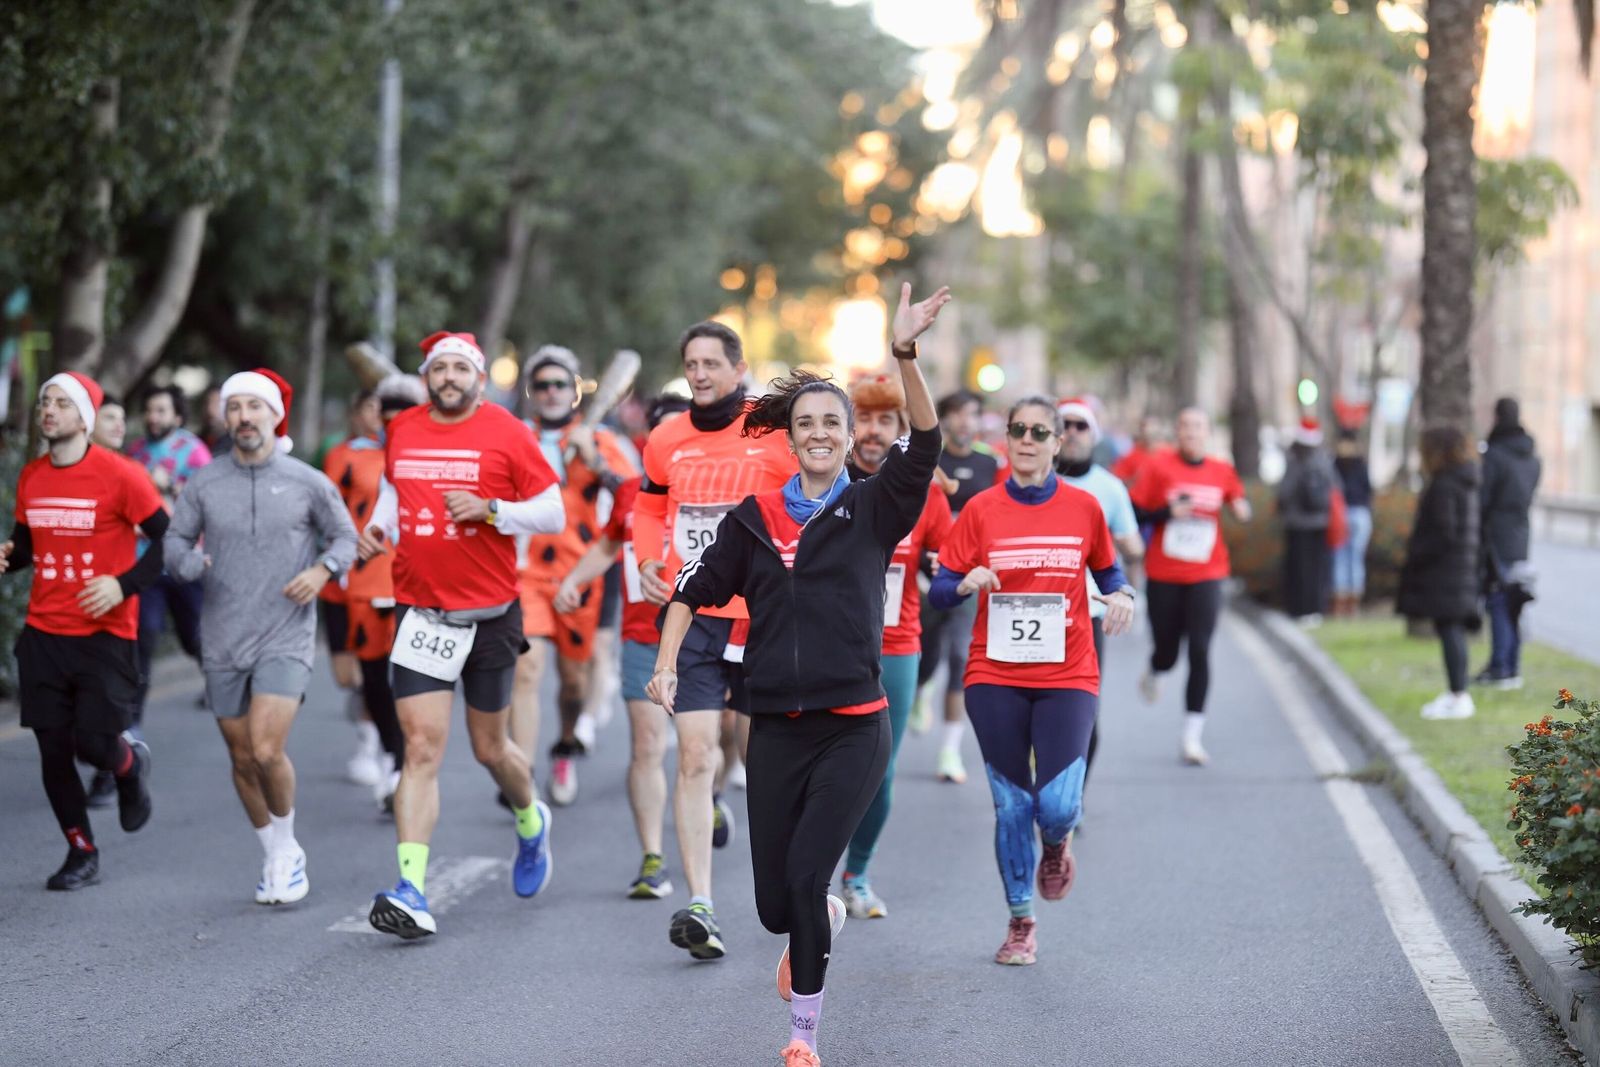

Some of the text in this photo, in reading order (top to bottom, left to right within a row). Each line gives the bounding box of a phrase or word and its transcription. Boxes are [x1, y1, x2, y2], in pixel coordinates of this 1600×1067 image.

[687, 529, 717, 549] 50
[1011, 619, 1042, 641] 52
[411, 631, 456, 659] 848
